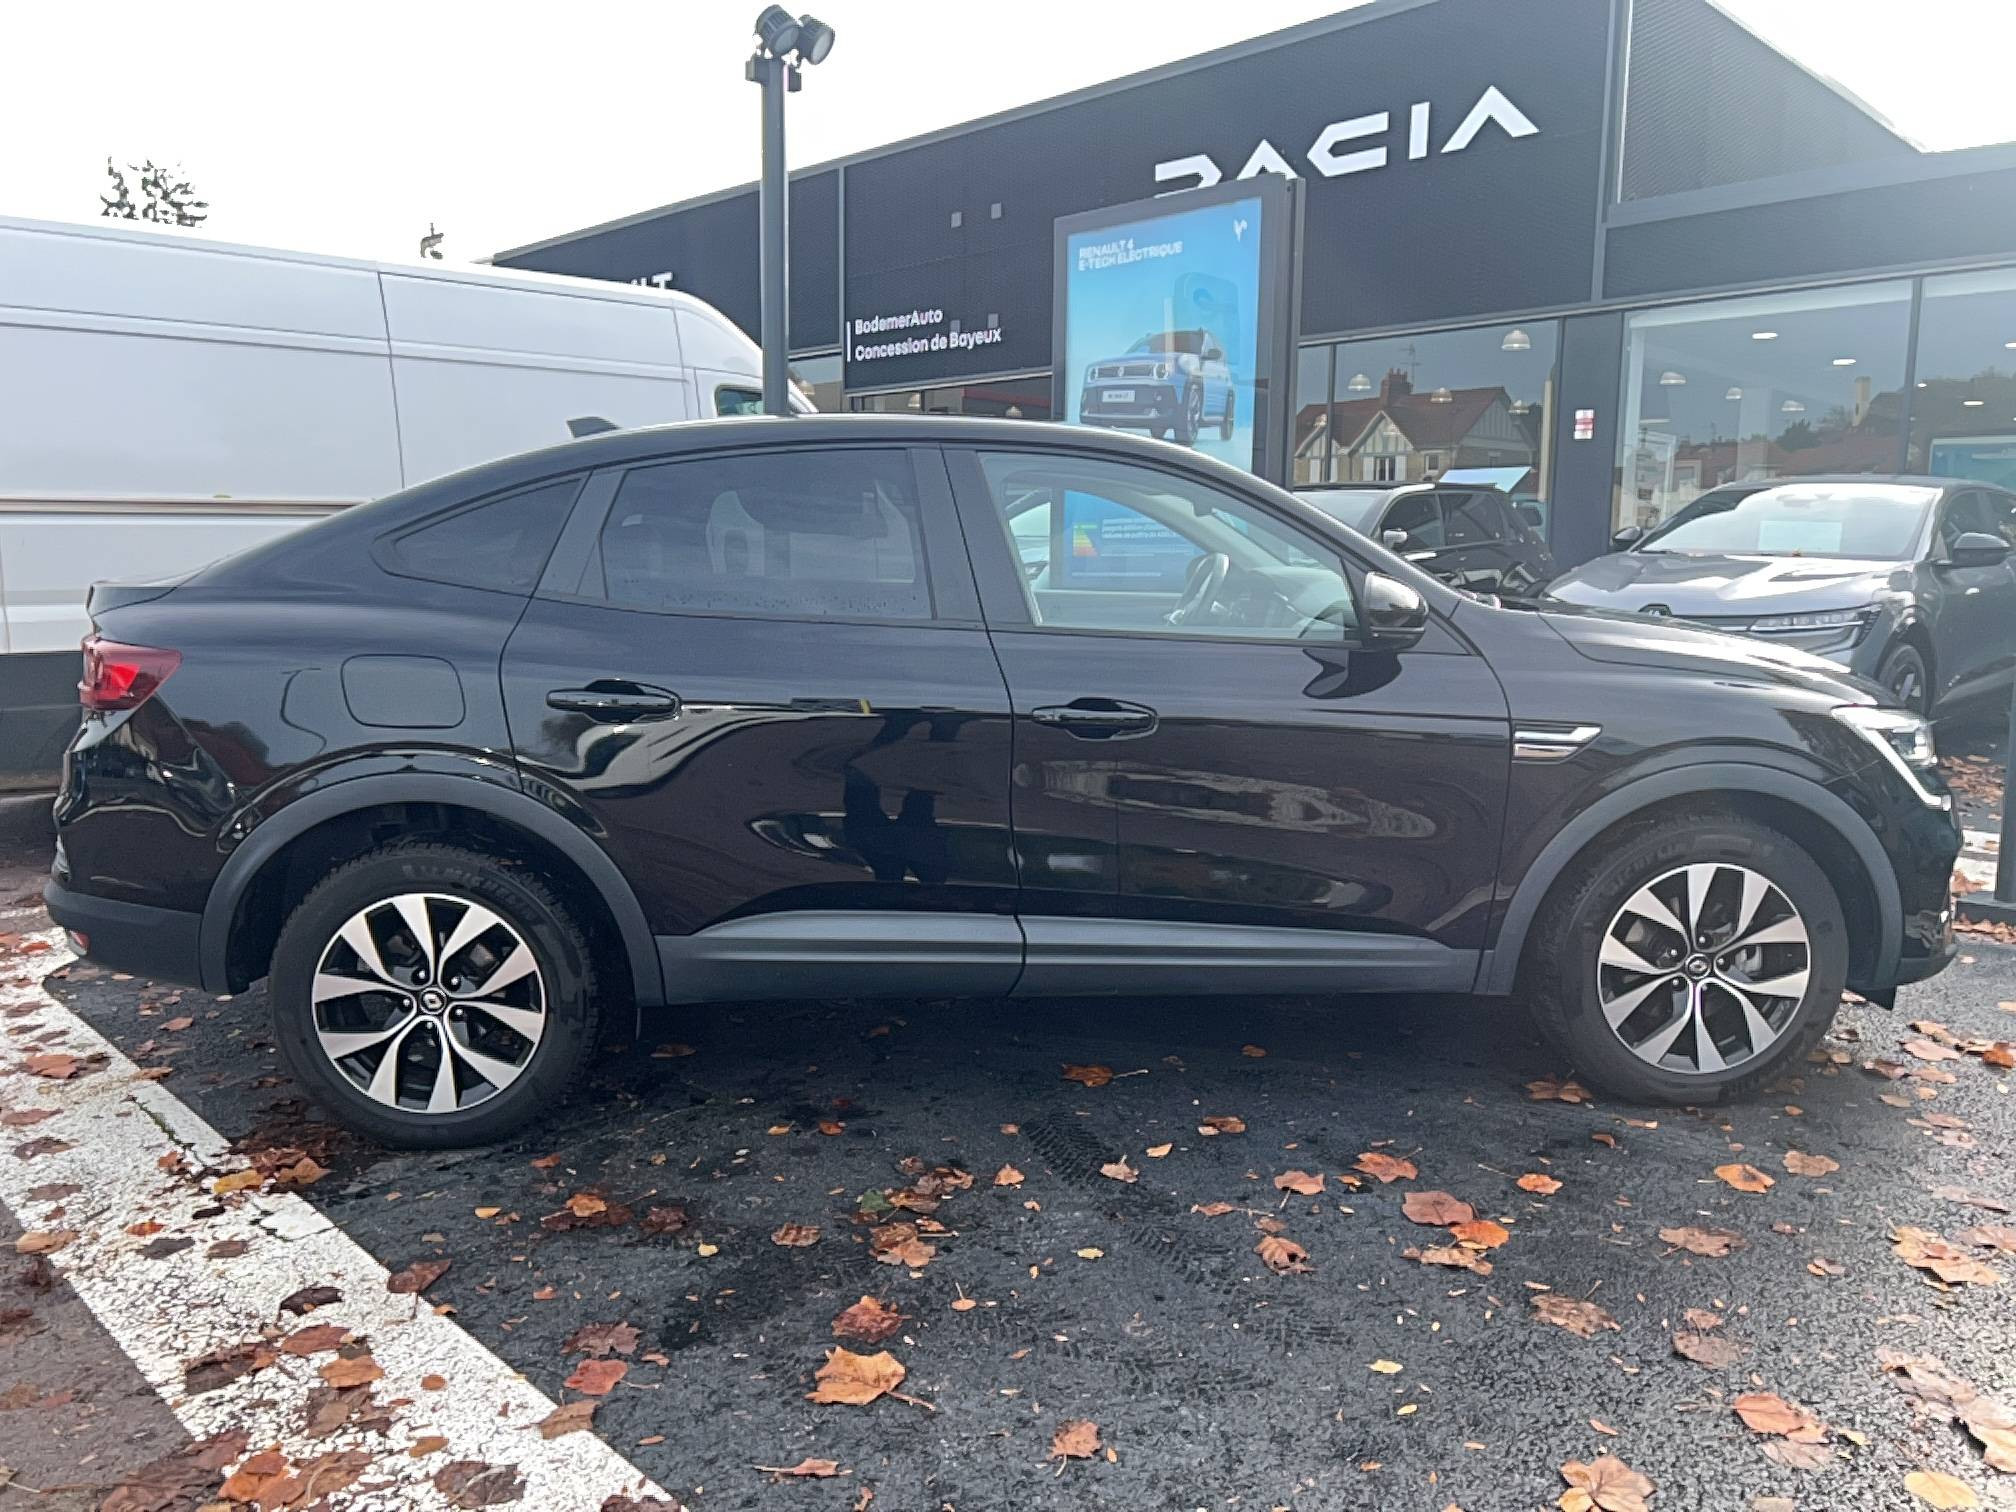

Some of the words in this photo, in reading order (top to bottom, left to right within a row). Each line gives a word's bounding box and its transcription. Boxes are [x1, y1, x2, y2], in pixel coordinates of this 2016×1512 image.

[1079, 239, 1127, 259] RENAULT
[854, 308, 944, 335] BodemerAuto
[854, 337, 929, 362] Concession
[930, 333, 948, 351] de
[949, 327, 1003, 351] Bayeux
